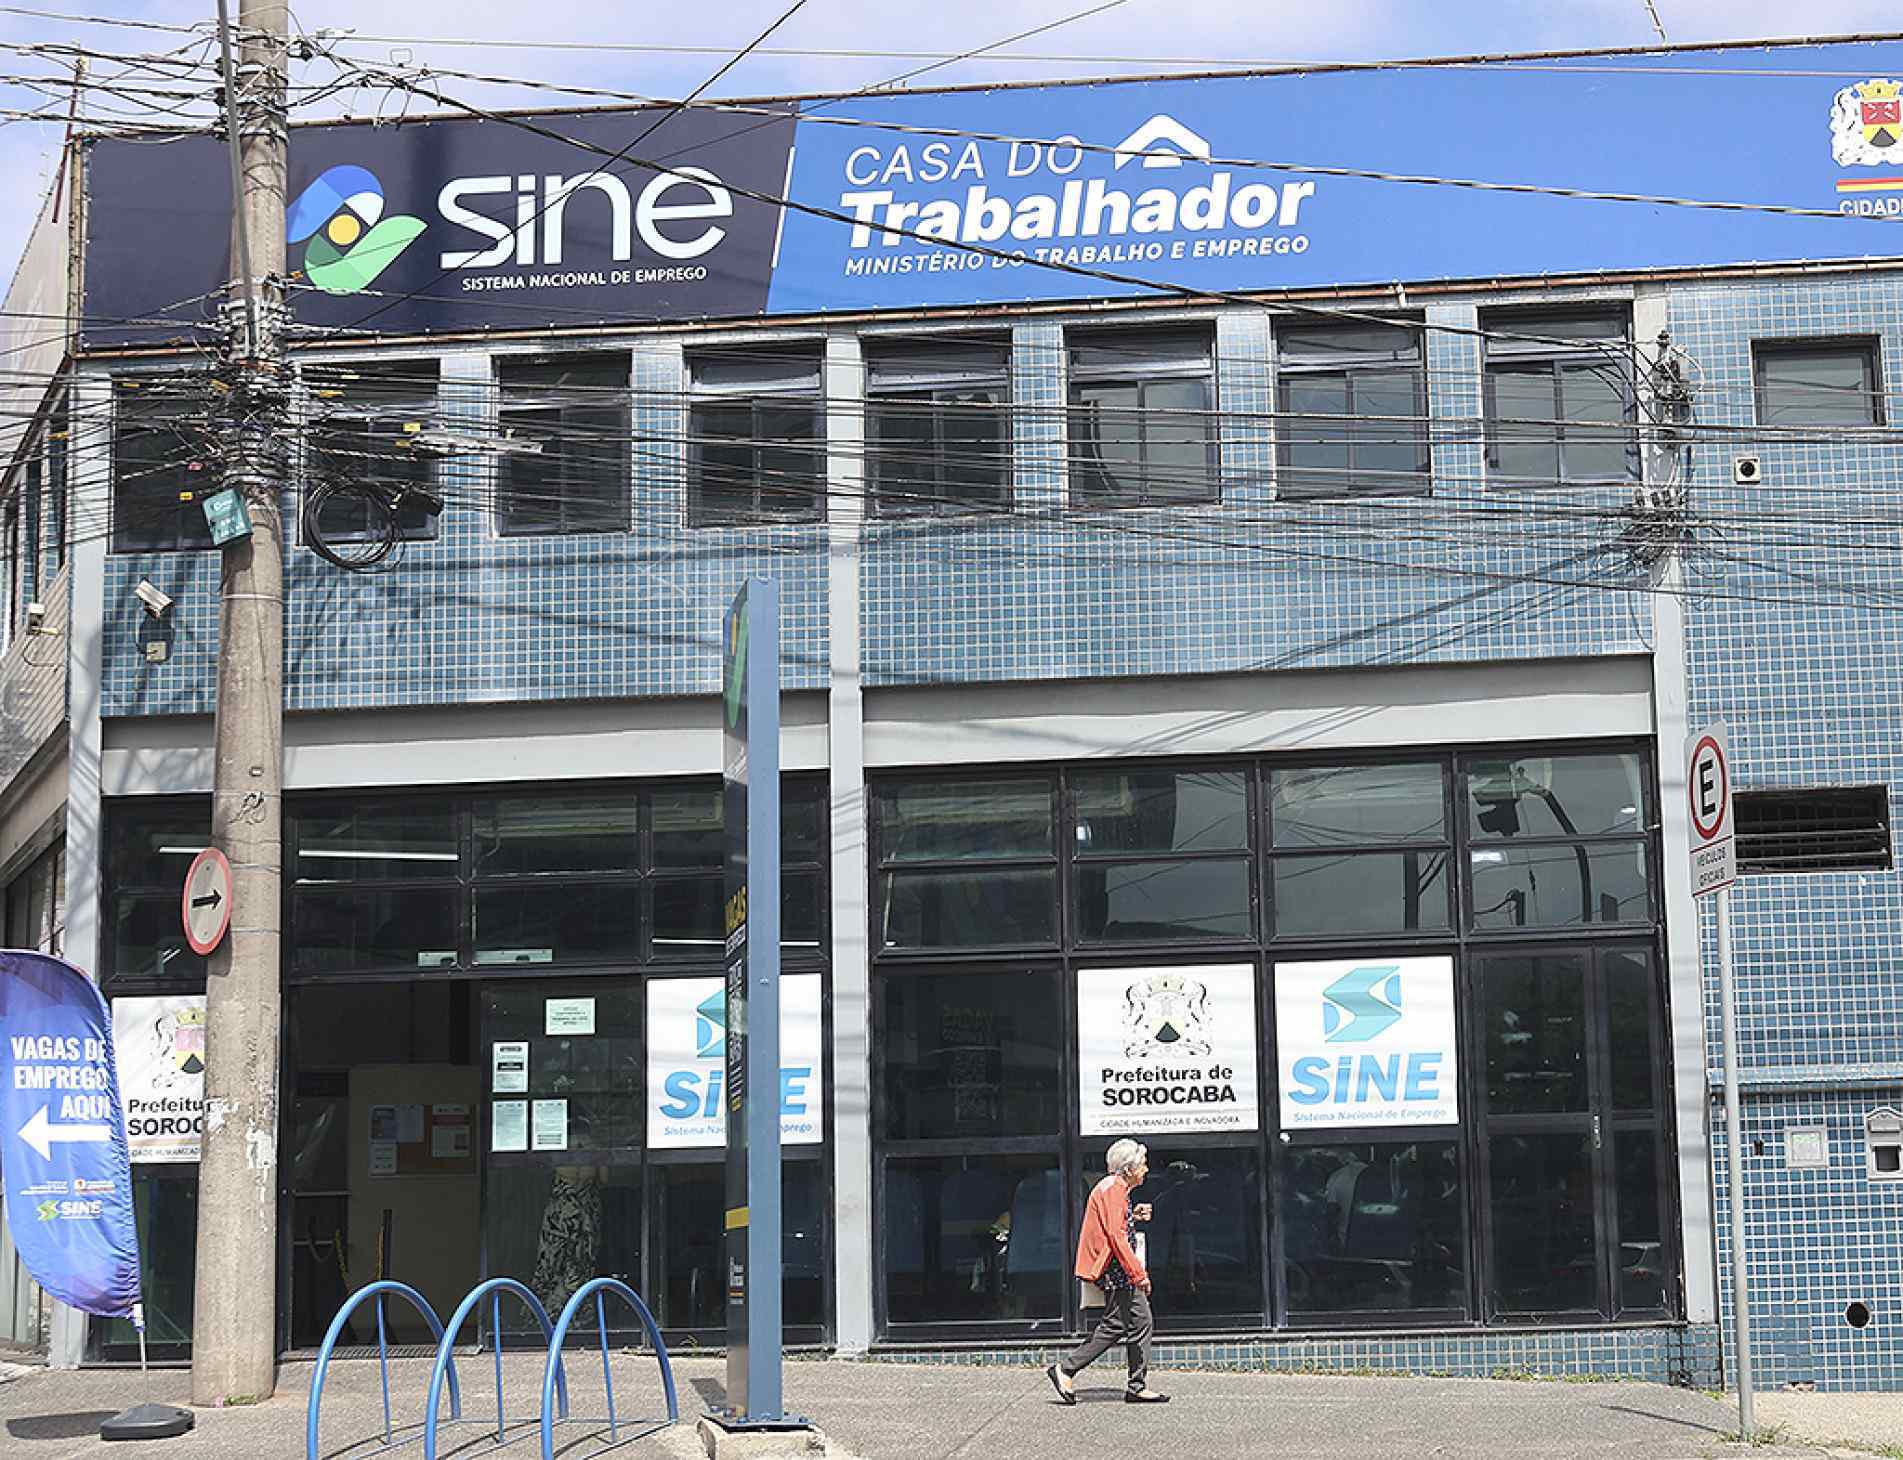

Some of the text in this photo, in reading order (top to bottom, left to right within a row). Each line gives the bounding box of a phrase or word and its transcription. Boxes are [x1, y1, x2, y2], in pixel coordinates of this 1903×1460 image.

[845, 135, 1083, 185] CASA DO
[840, 172, 1316, 248] Trabalhador
[1839, 198, 1903, 217] CIDAD
[845, 235, 1310, 277] MINISTÉRIO DO TRABALHO E EMPREGO
[462, 266, 707, 291] SISTEMA NACIONAL DE EMPREGO
[1700, 759, 1716, 817] E
[10, 1036, 81, 1061] VAGAS
[14, 1065, 107, 1090] EMPREGO
[1101, 1064, 1233, 1083] Prefeitura de
[60, 1095, 111, 1120] AQUI
[1102, 1084, 1237, 1106] SOROCABA
[1294, 1106, 1447, 1122] Sistema Nacional de Emprego
